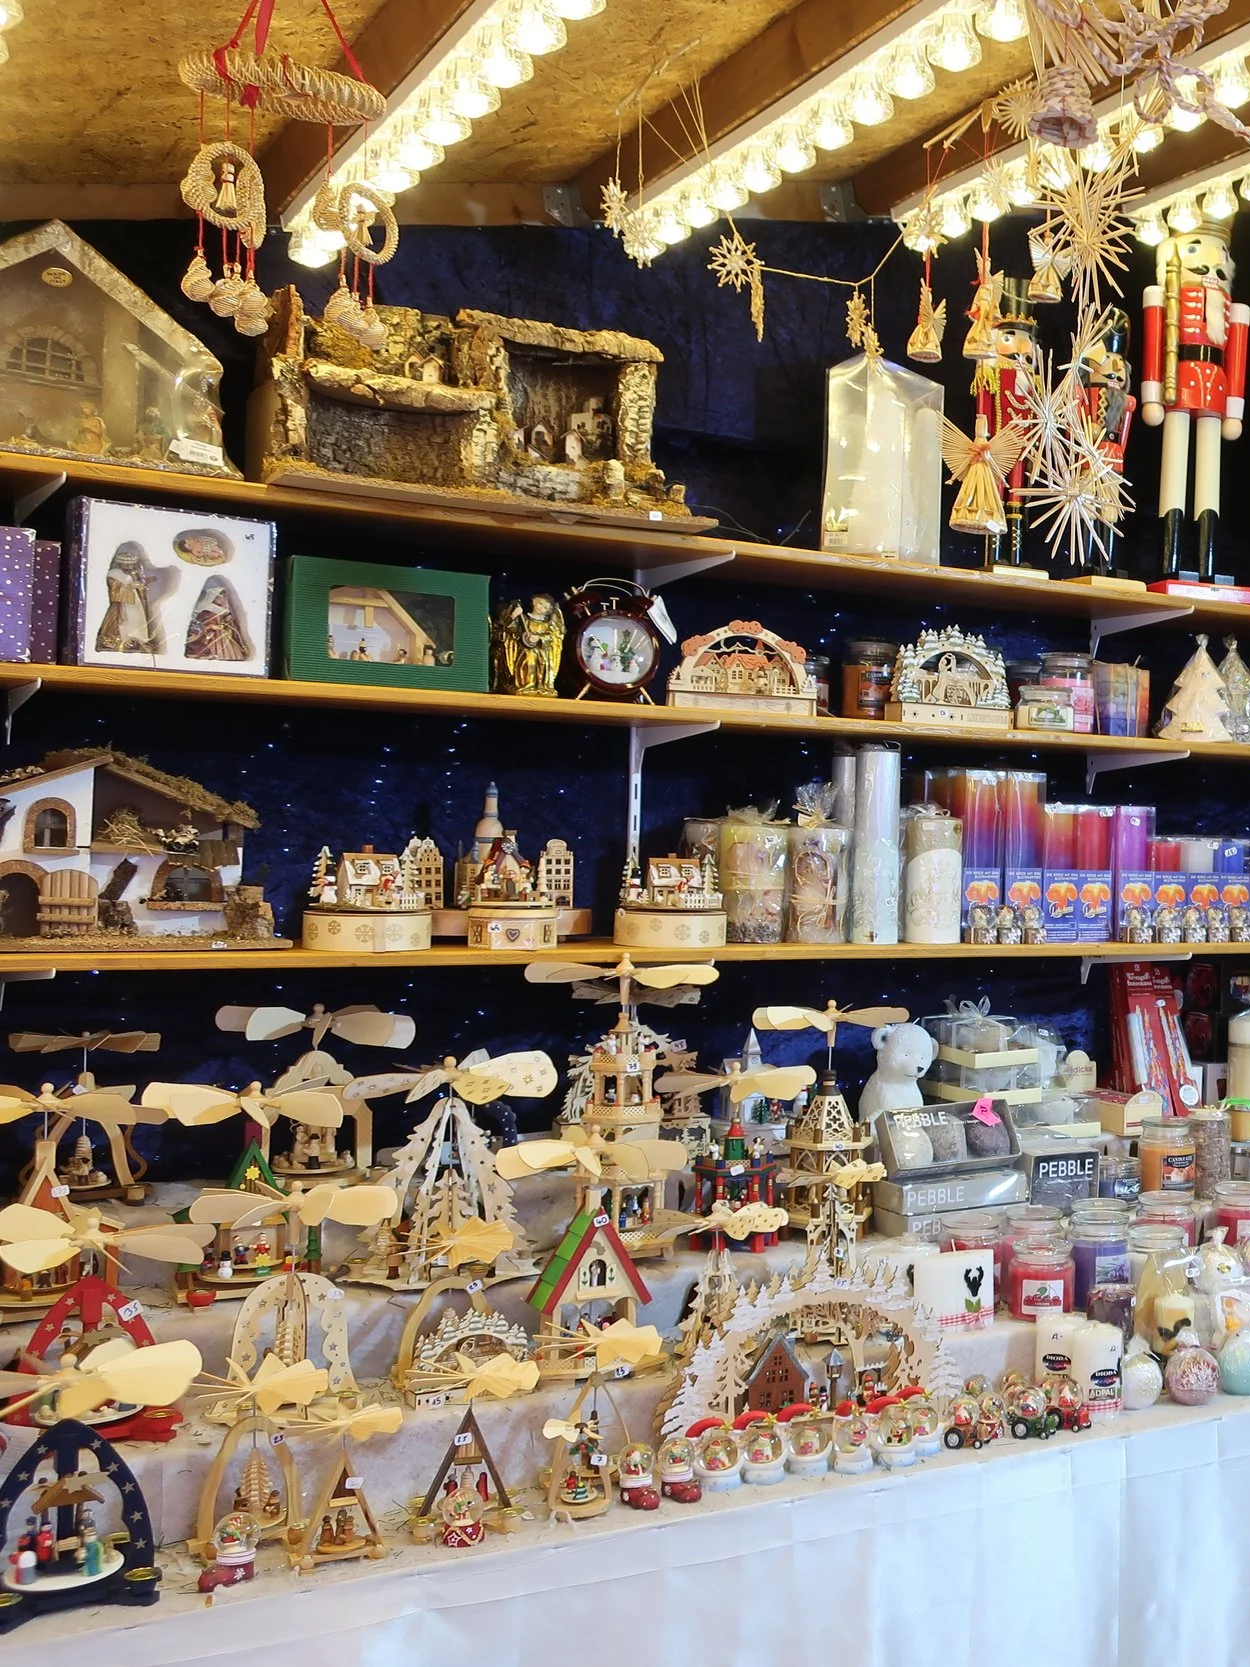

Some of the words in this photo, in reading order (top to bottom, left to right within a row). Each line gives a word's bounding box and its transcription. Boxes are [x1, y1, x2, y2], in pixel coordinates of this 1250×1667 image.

[893, 1111, 949, 1130] PEBBLE
[1039, 1158, 1094, 1178] PEBBLE
[907, 1186, 965, 1208] PEBBLE
[912, 1219, 942, 1235] PEB
[123, 1302, 139, 1317] 35
[1089, 1388, 1115, 1398] ADPAL
[431, 1397, 441, 1406] 15
